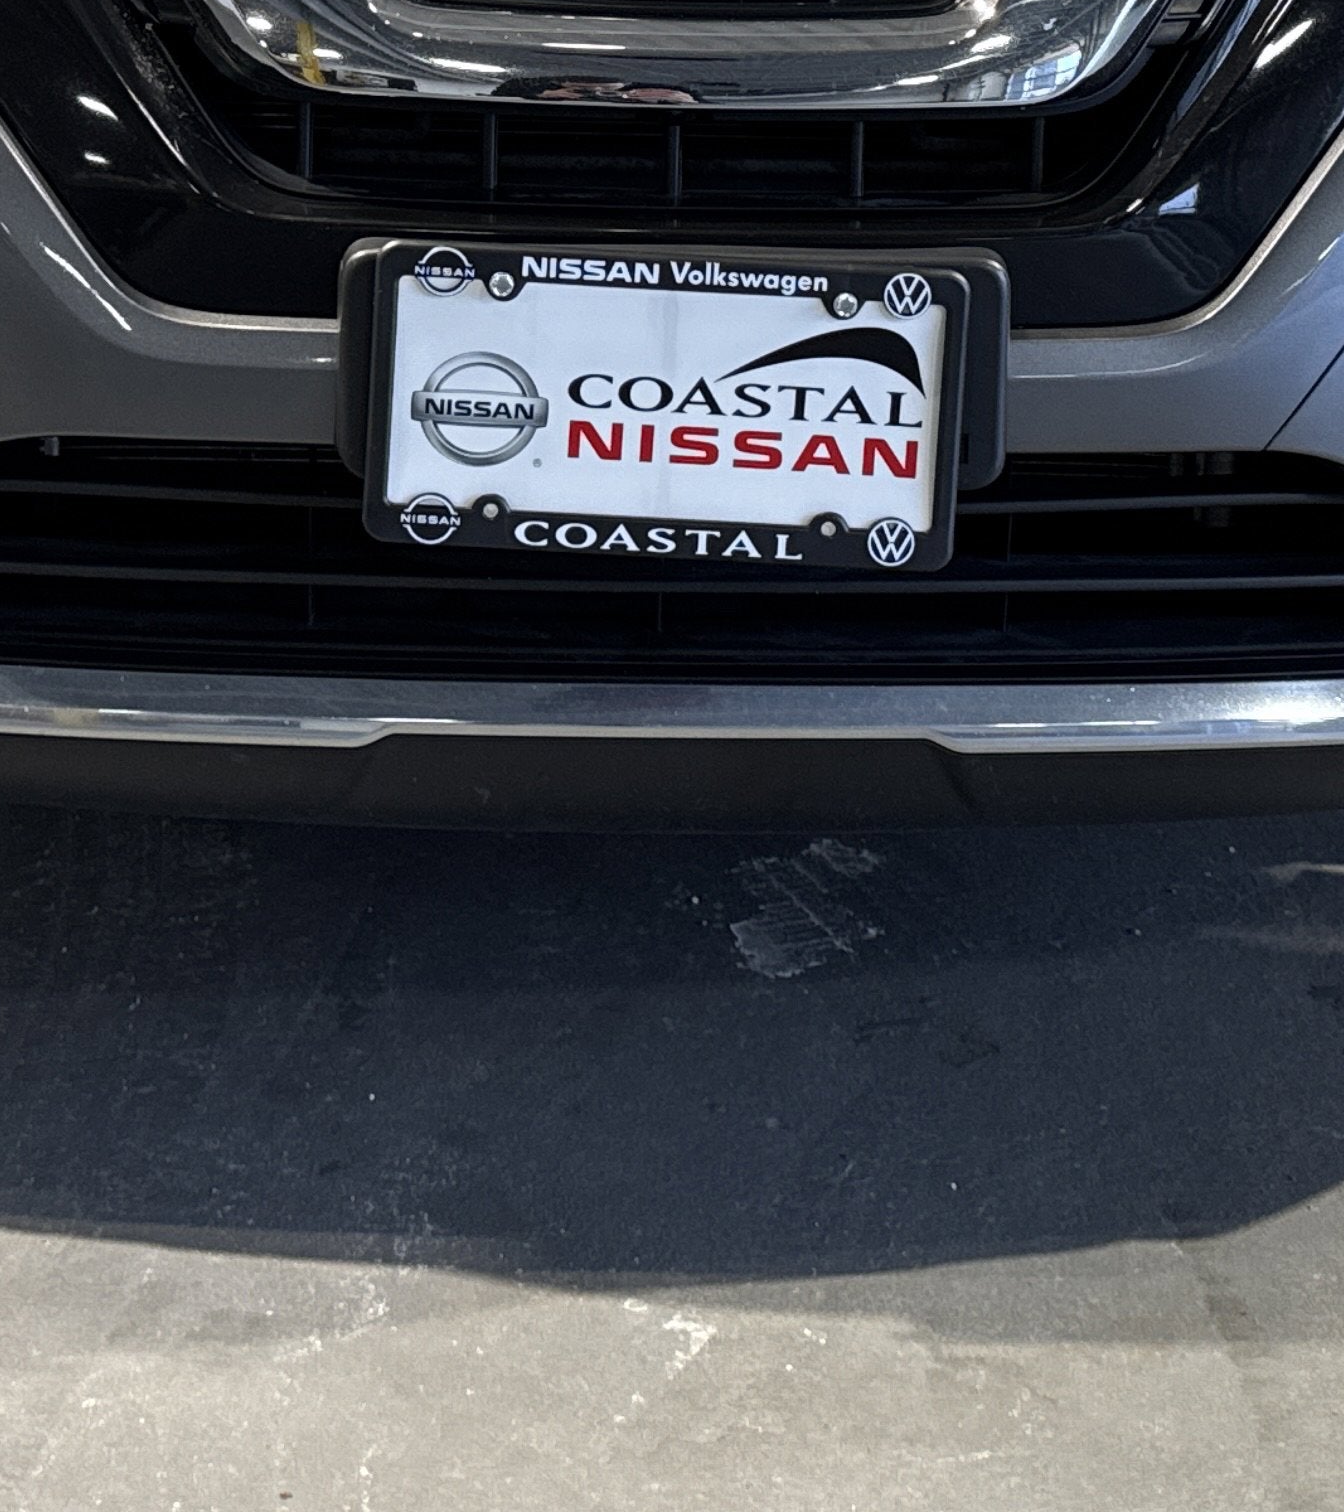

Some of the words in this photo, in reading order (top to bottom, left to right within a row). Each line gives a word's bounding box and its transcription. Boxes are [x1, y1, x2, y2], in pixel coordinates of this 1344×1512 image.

[414, 265, 475, 278] NISSAN
[522, 256, 660, 284] NISSAN
[670, 261, 828, 294] Volkswagen
[424, 398, 534, 420] NISSAN
[567, 374, 924, 428] COASTAL
[567, 420, 919, 480] NISSAN
[400, 513, 461, 526] NISSAN
[514, 520, 803, 561] COASTAL
